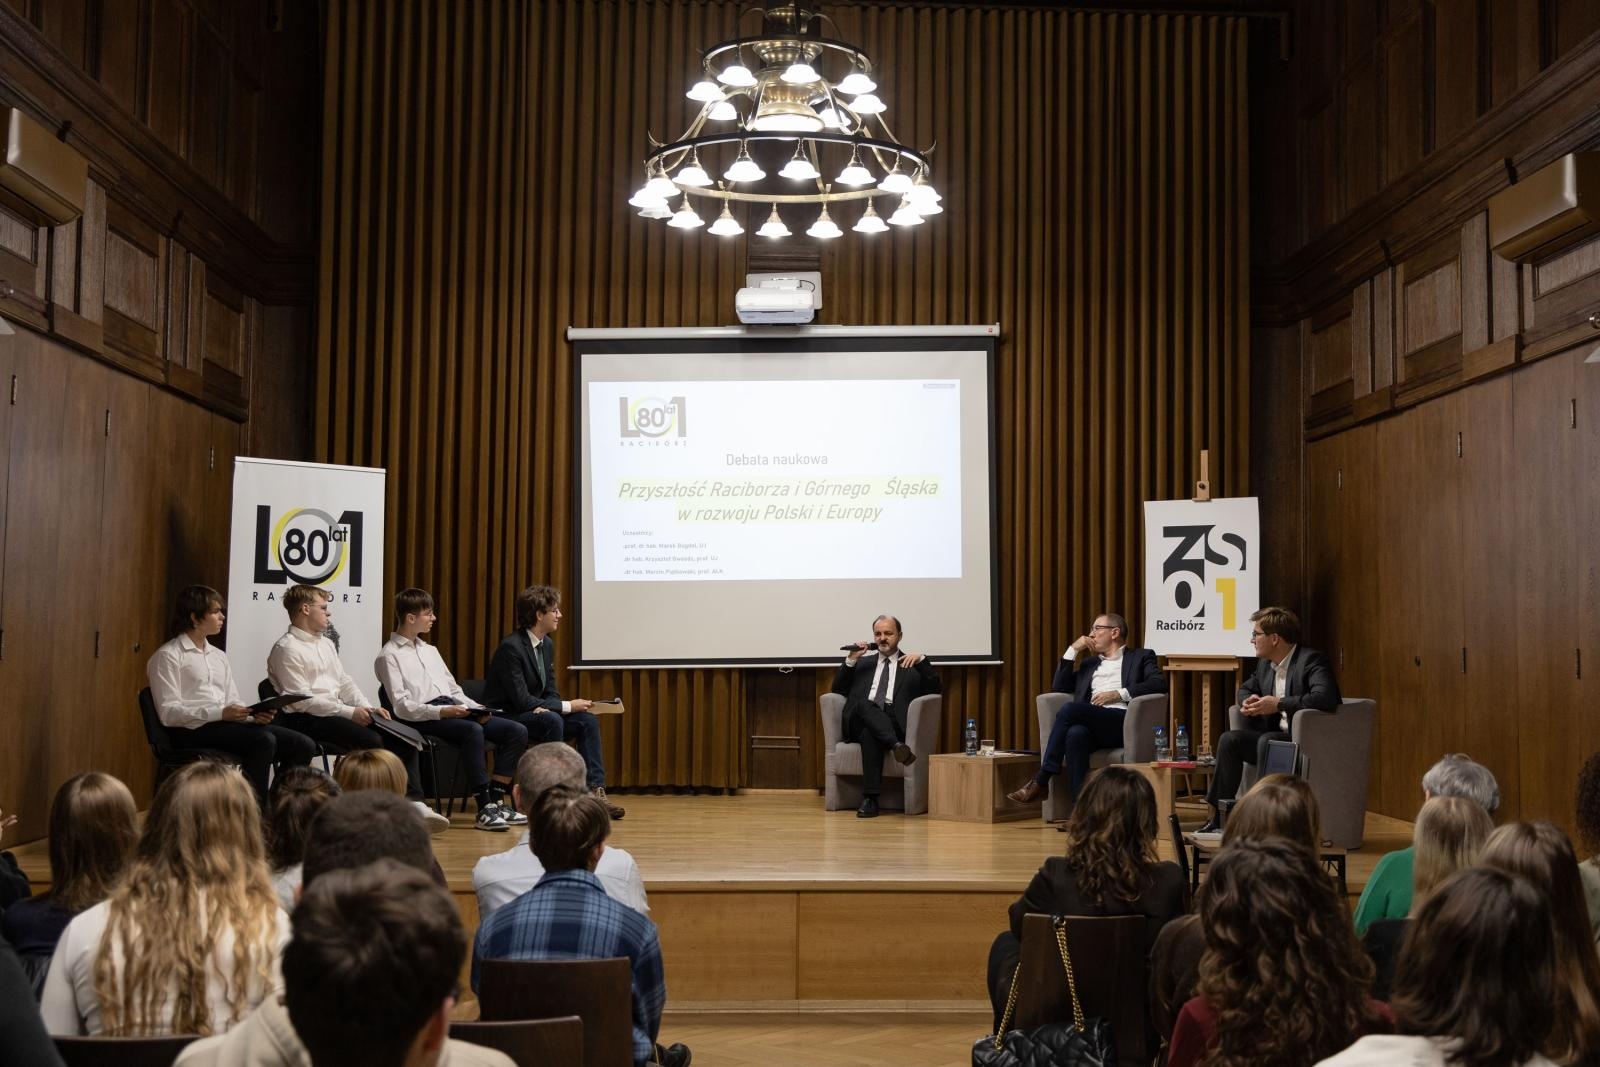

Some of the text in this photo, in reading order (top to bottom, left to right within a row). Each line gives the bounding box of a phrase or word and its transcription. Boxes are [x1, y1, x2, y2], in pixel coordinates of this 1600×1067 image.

[637, 408, 665, 428] 80
[726, 453, 828, 466] Debata naukowa
[618, 476, 938, 502] Przyszłość Raciborza i Górnego Śląska
[678, 503, 884, 525] w rozwoju Polski i Europy
[284, 526, 348, 567] 80 lat
[1156, 619, 1205, 632] Racibórz
